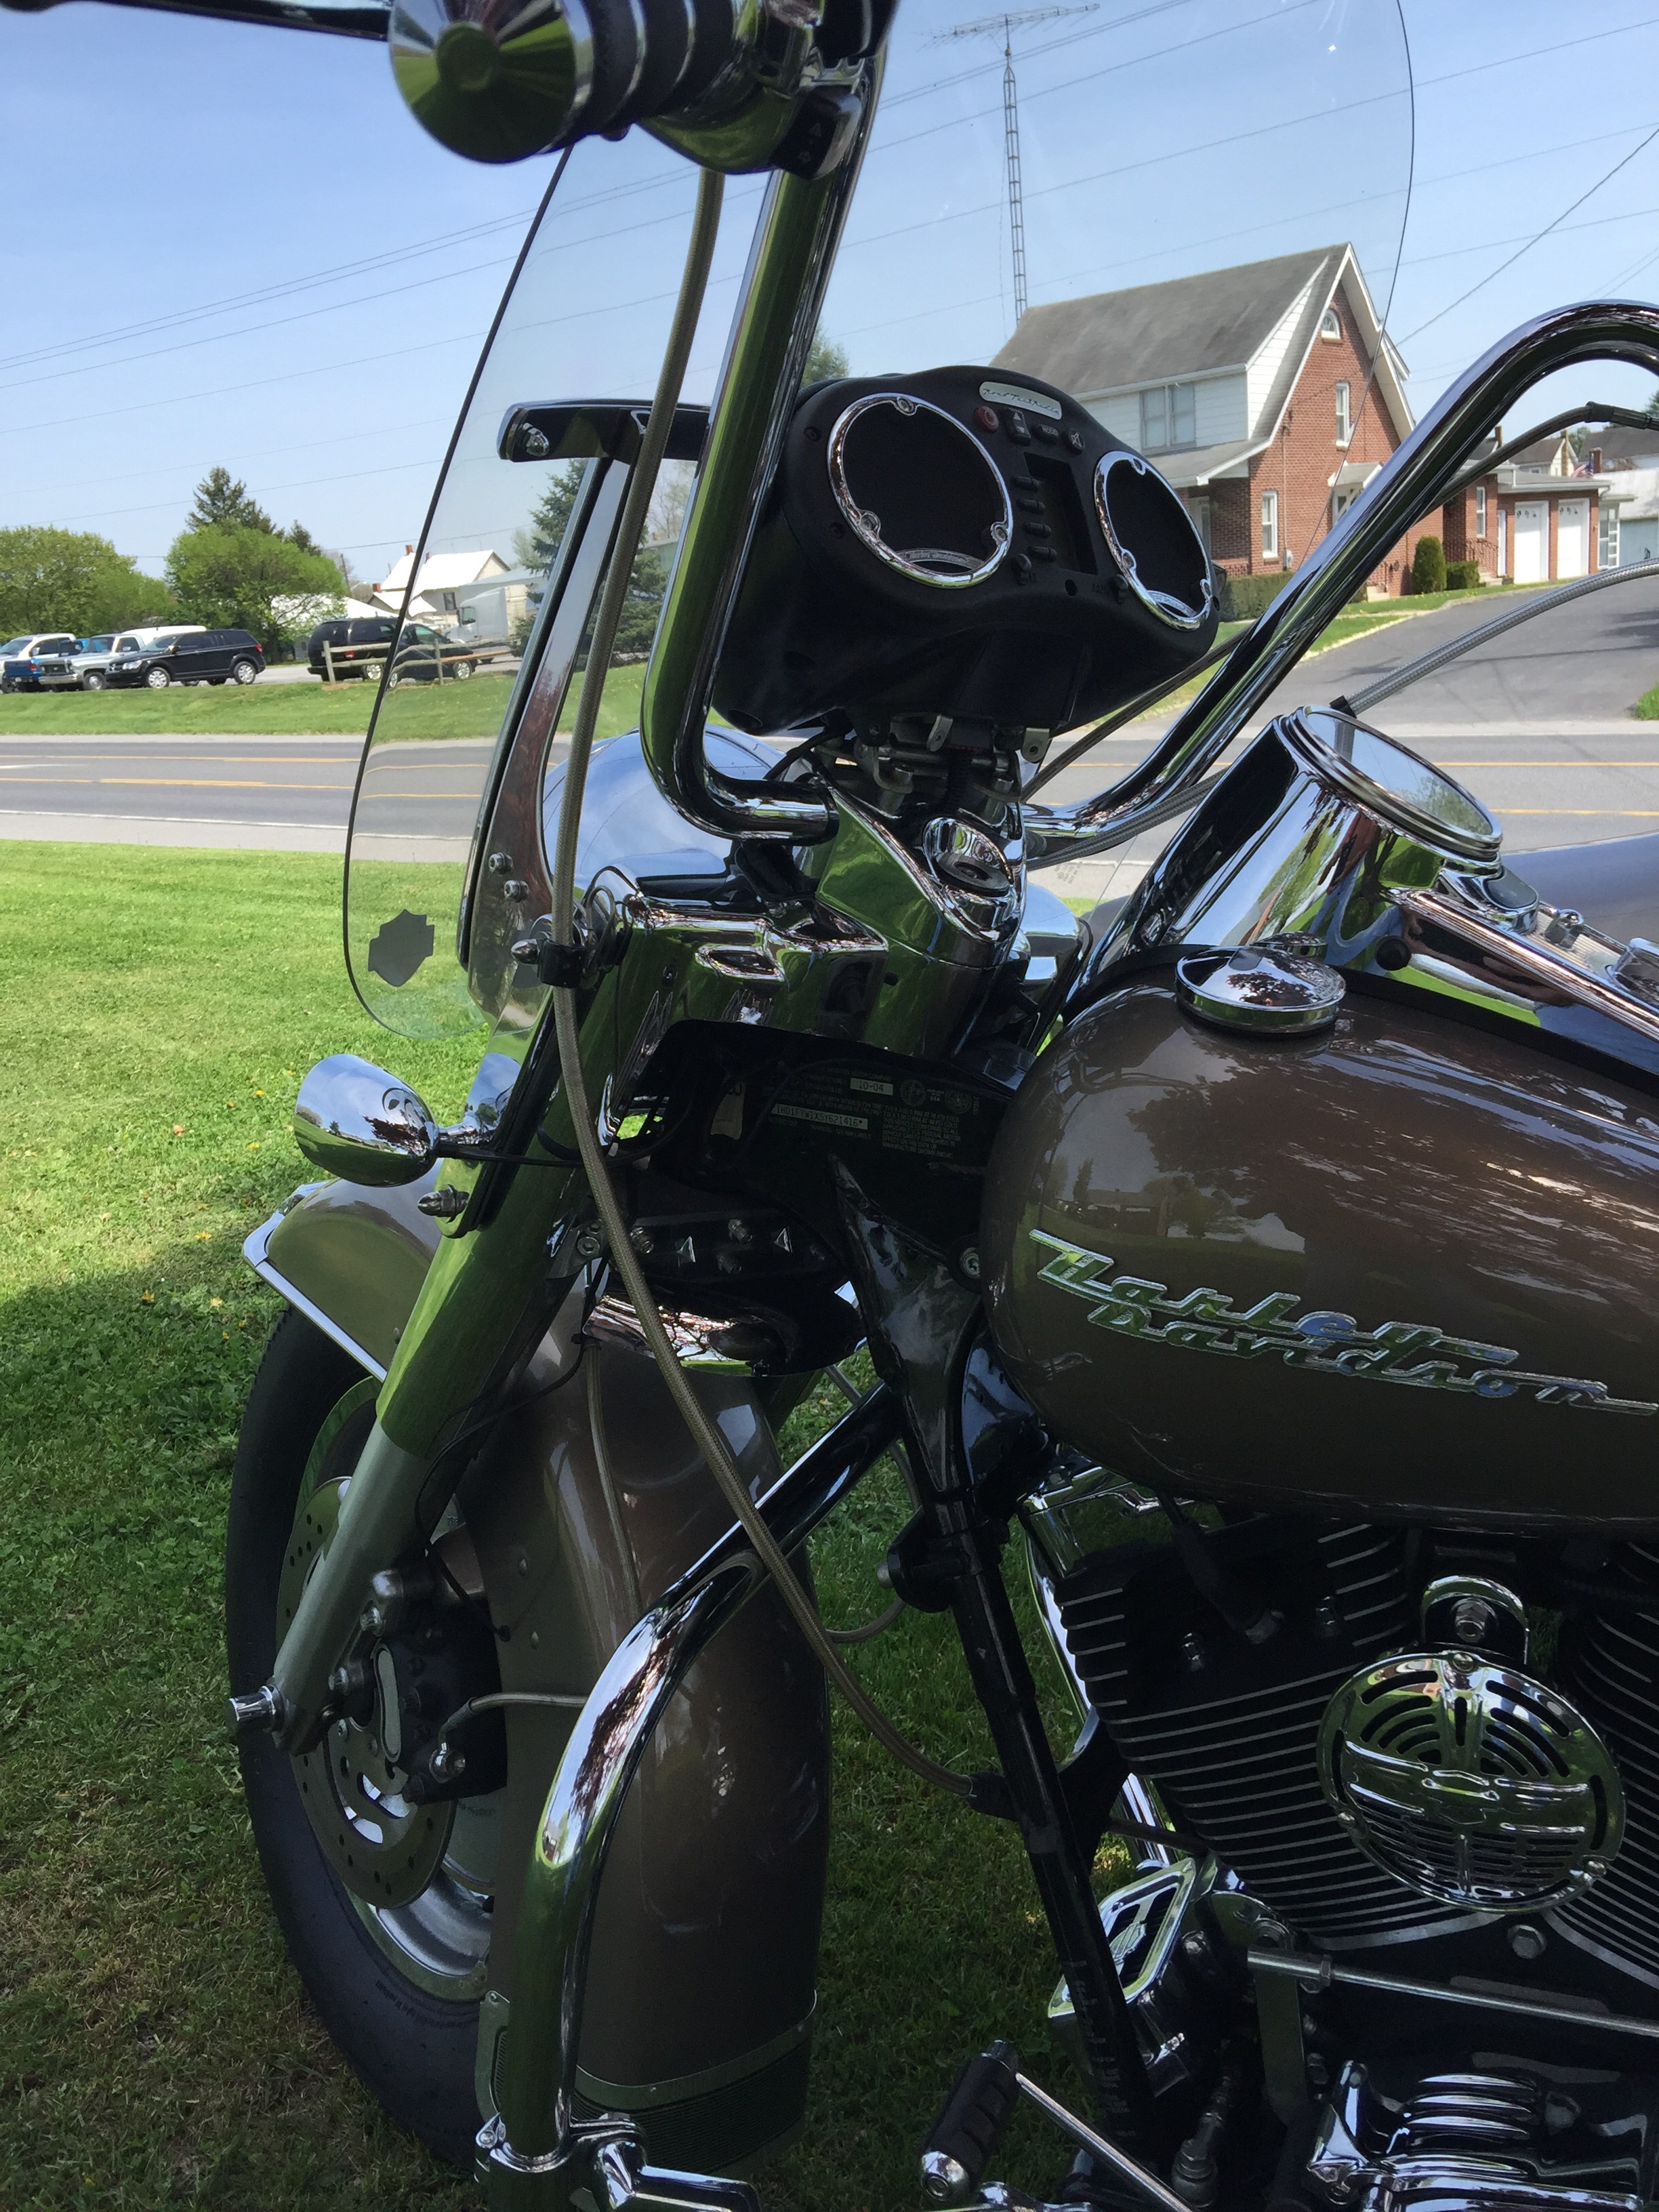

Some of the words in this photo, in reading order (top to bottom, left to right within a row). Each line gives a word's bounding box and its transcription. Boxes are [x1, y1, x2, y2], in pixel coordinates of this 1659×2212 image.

[859, 1080, 884, 1092] 10-04
[1029, 1227, 1519, 1364] Harley
[1086, 1300, 1658, 1417] Davidson
